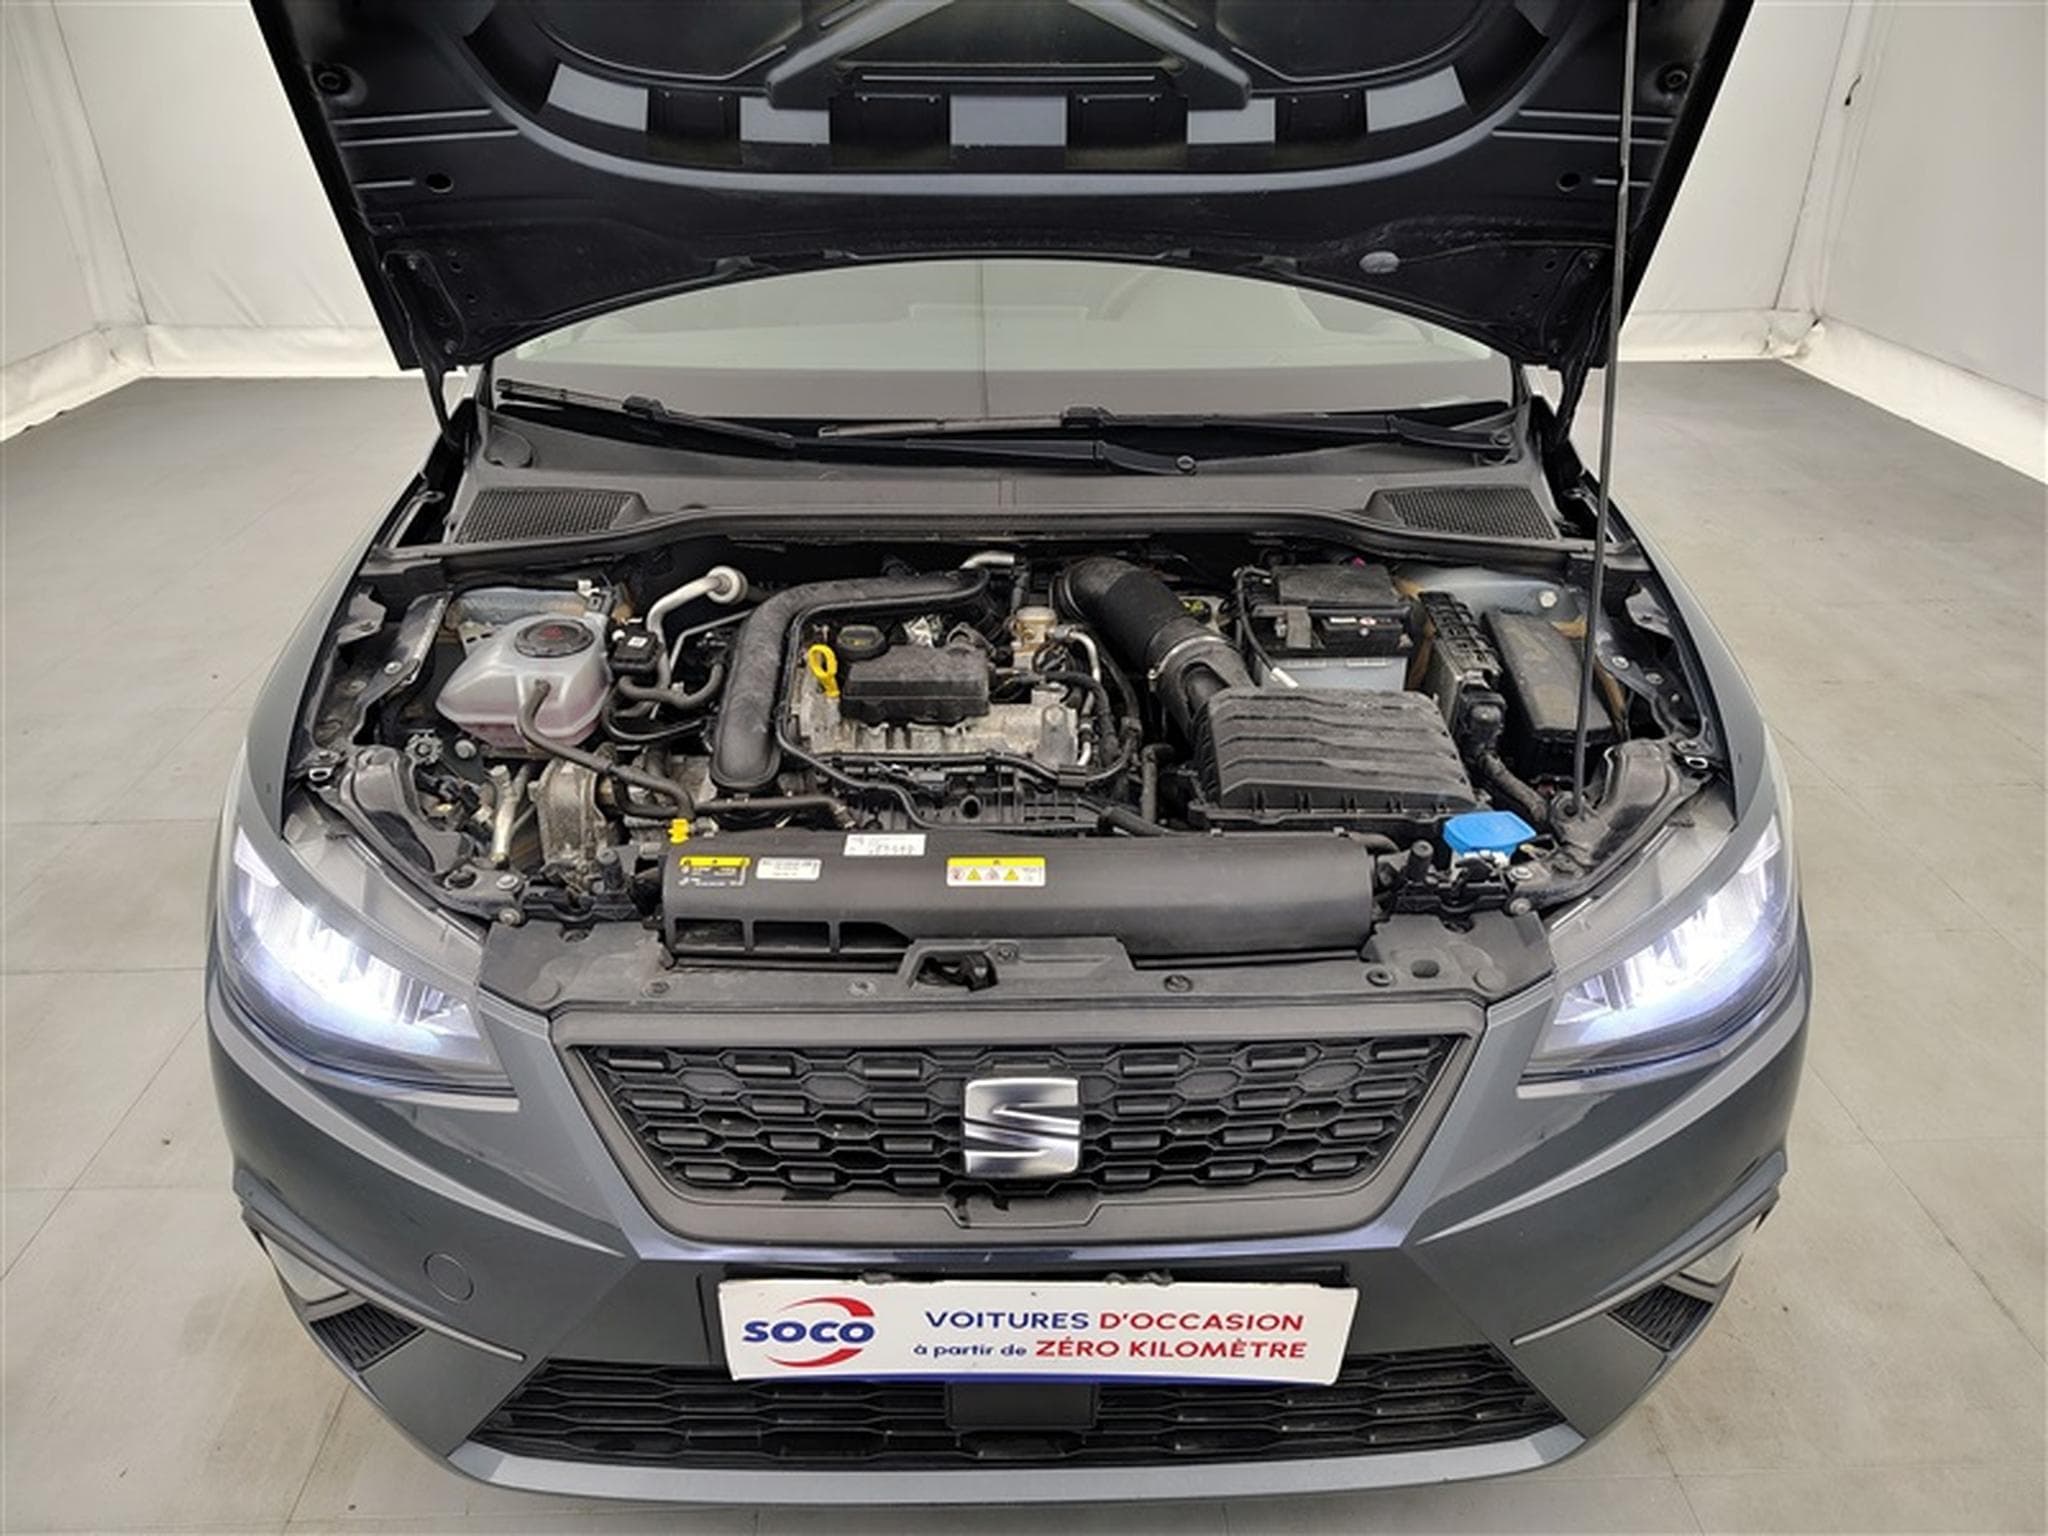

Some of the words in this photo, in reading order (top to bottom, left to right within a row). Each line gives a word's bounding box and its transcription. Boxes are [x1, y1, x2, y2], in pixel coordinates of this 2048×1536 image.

[743, 1321, 875, 1344] SOCO
[926, 1311, 1089, 1330] VOITURES
[1099, 1312, 1305, 1331] D'OCCASION
[913, 1343, 928, 1356] à
[933, 1343, 994, 1359] partir
[1000, 1343, 1027, 1357] de
[1035, 1336, 1120, 1358] ZÉRO
[1129, 1337, 1308, 1359] KILOMÈTRE
